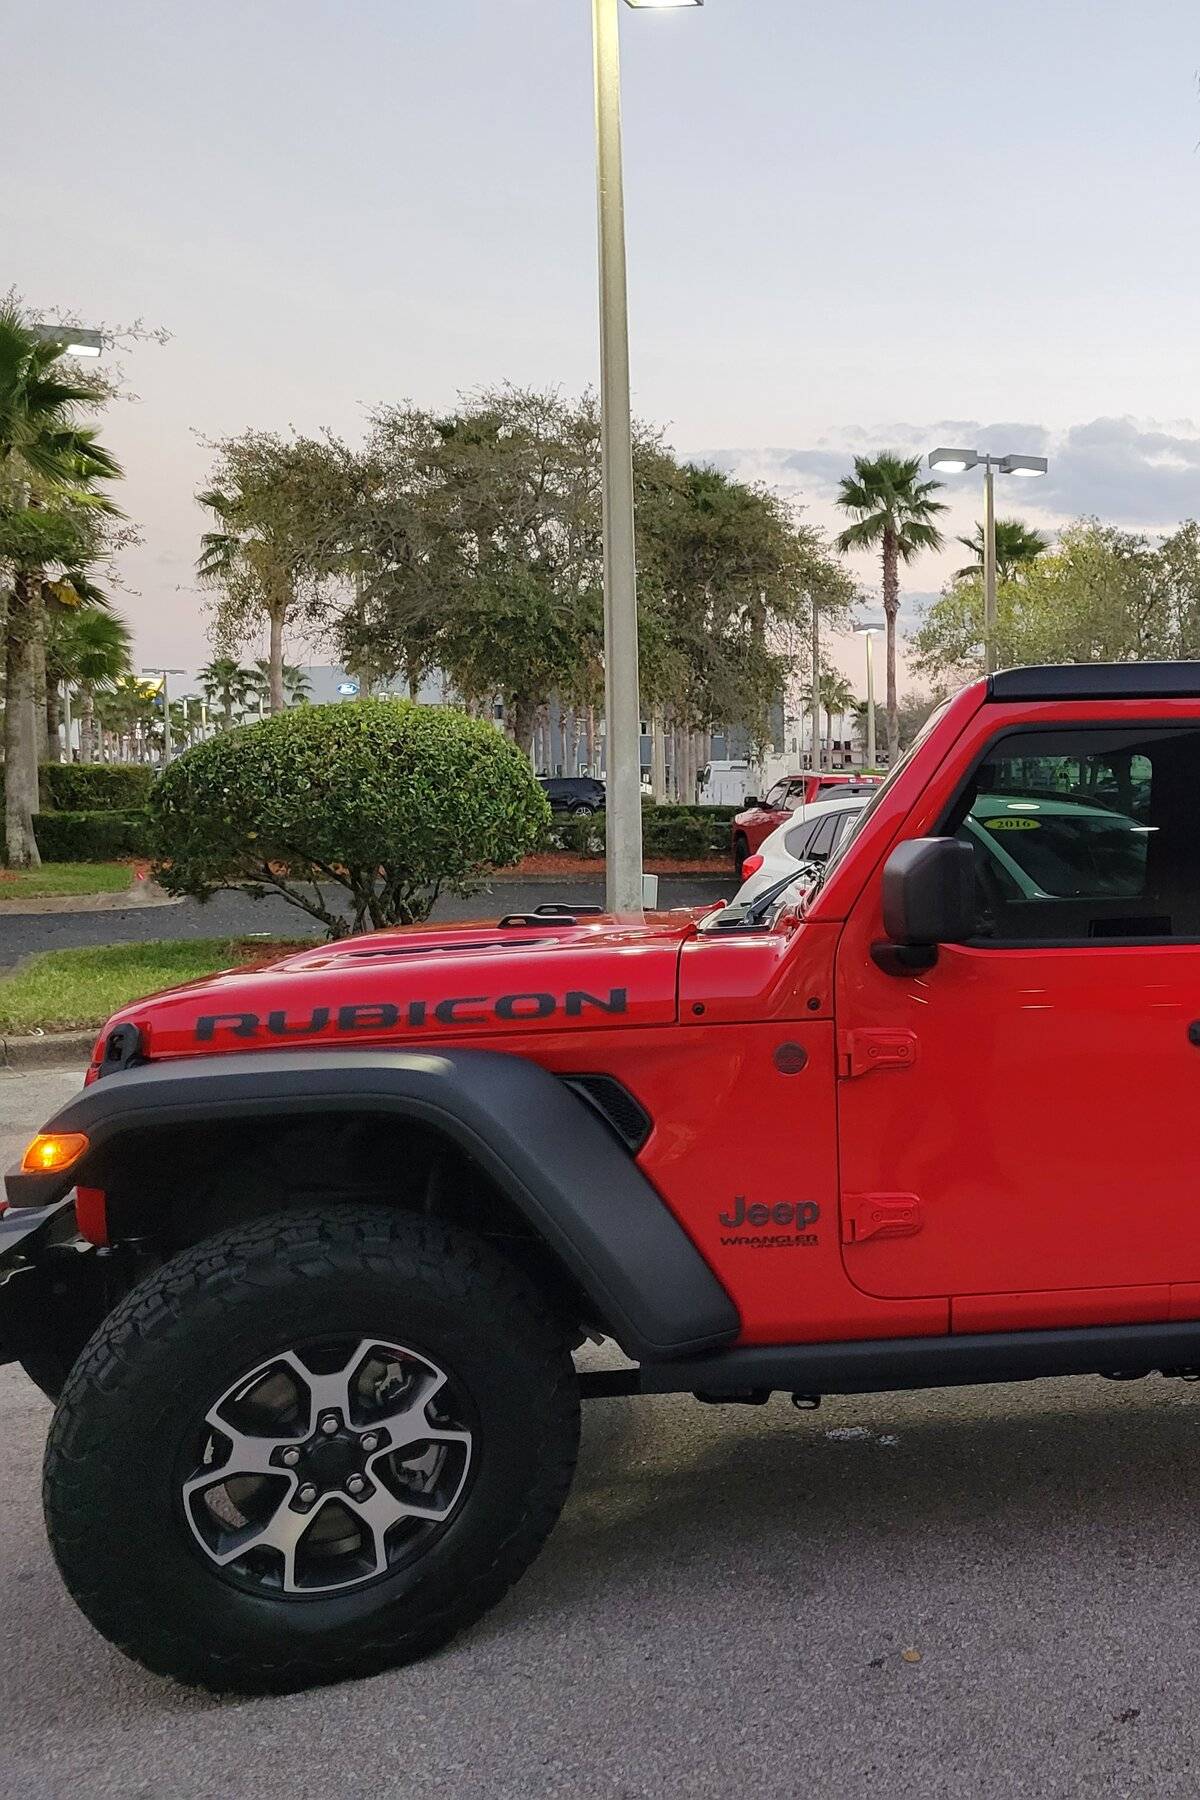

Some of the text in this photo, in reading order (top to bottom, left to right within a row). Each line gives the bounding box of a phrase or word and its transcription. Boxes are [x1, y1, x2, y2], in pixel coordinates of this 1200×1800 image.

[997, 820, 1031, 829] 2016
[197, 987, 627, 1041] RUBICON
[719, 1194, 819, 1231] Jeep
[720, 1233, 819, 1246] WRANGLER
